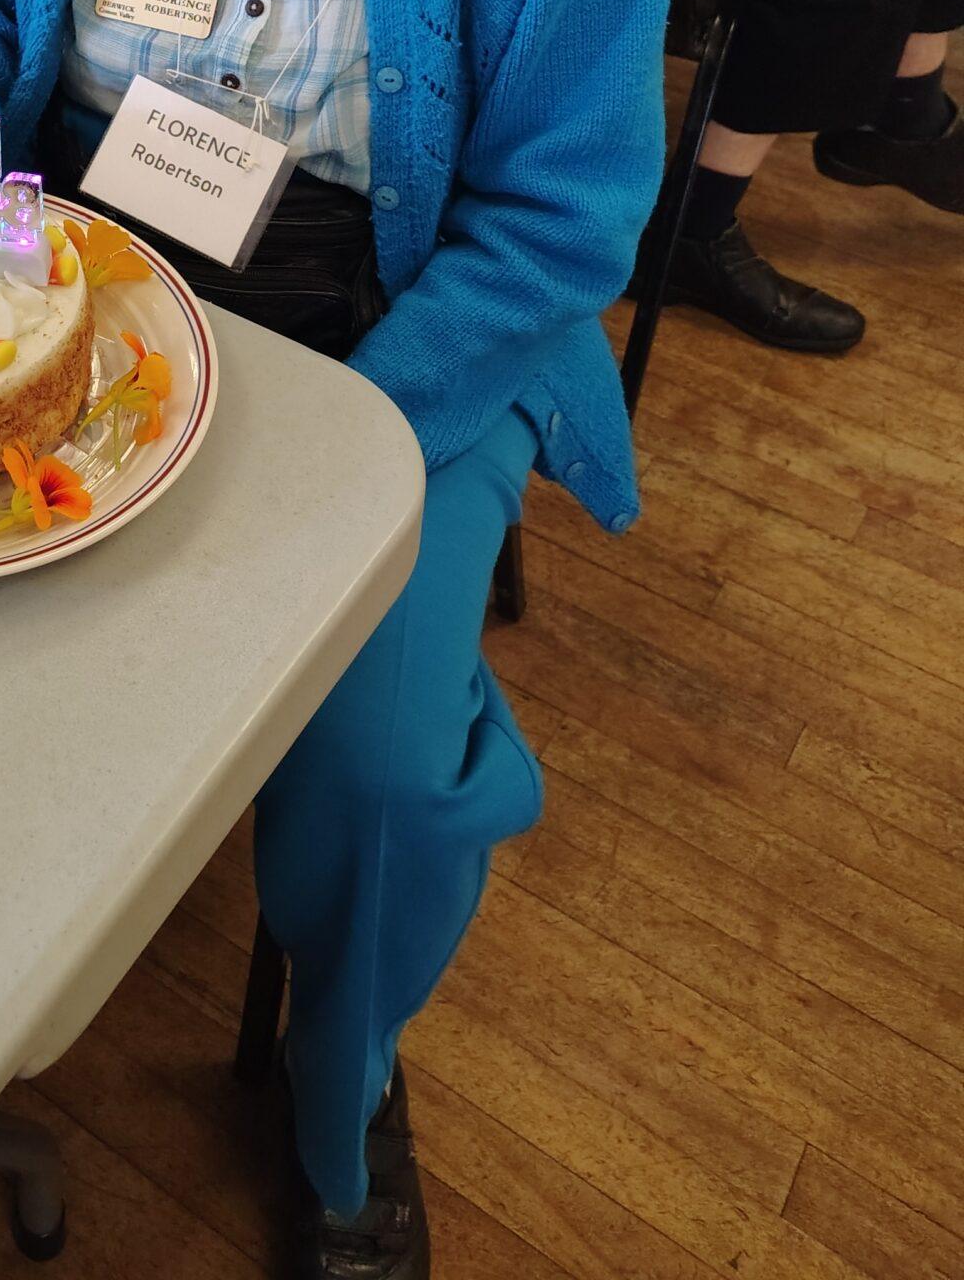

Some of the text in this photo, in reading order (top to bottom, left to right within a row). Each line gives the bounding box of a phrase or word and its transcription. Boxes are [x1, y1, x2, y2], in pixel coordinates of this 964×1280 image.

[119, 10, 135, 21] Valley
[144, 2, 212, 26] ROBERTSON
[145, 108, 253, 171] FLORENCE
[130, 142, 224, 199] Robertson
